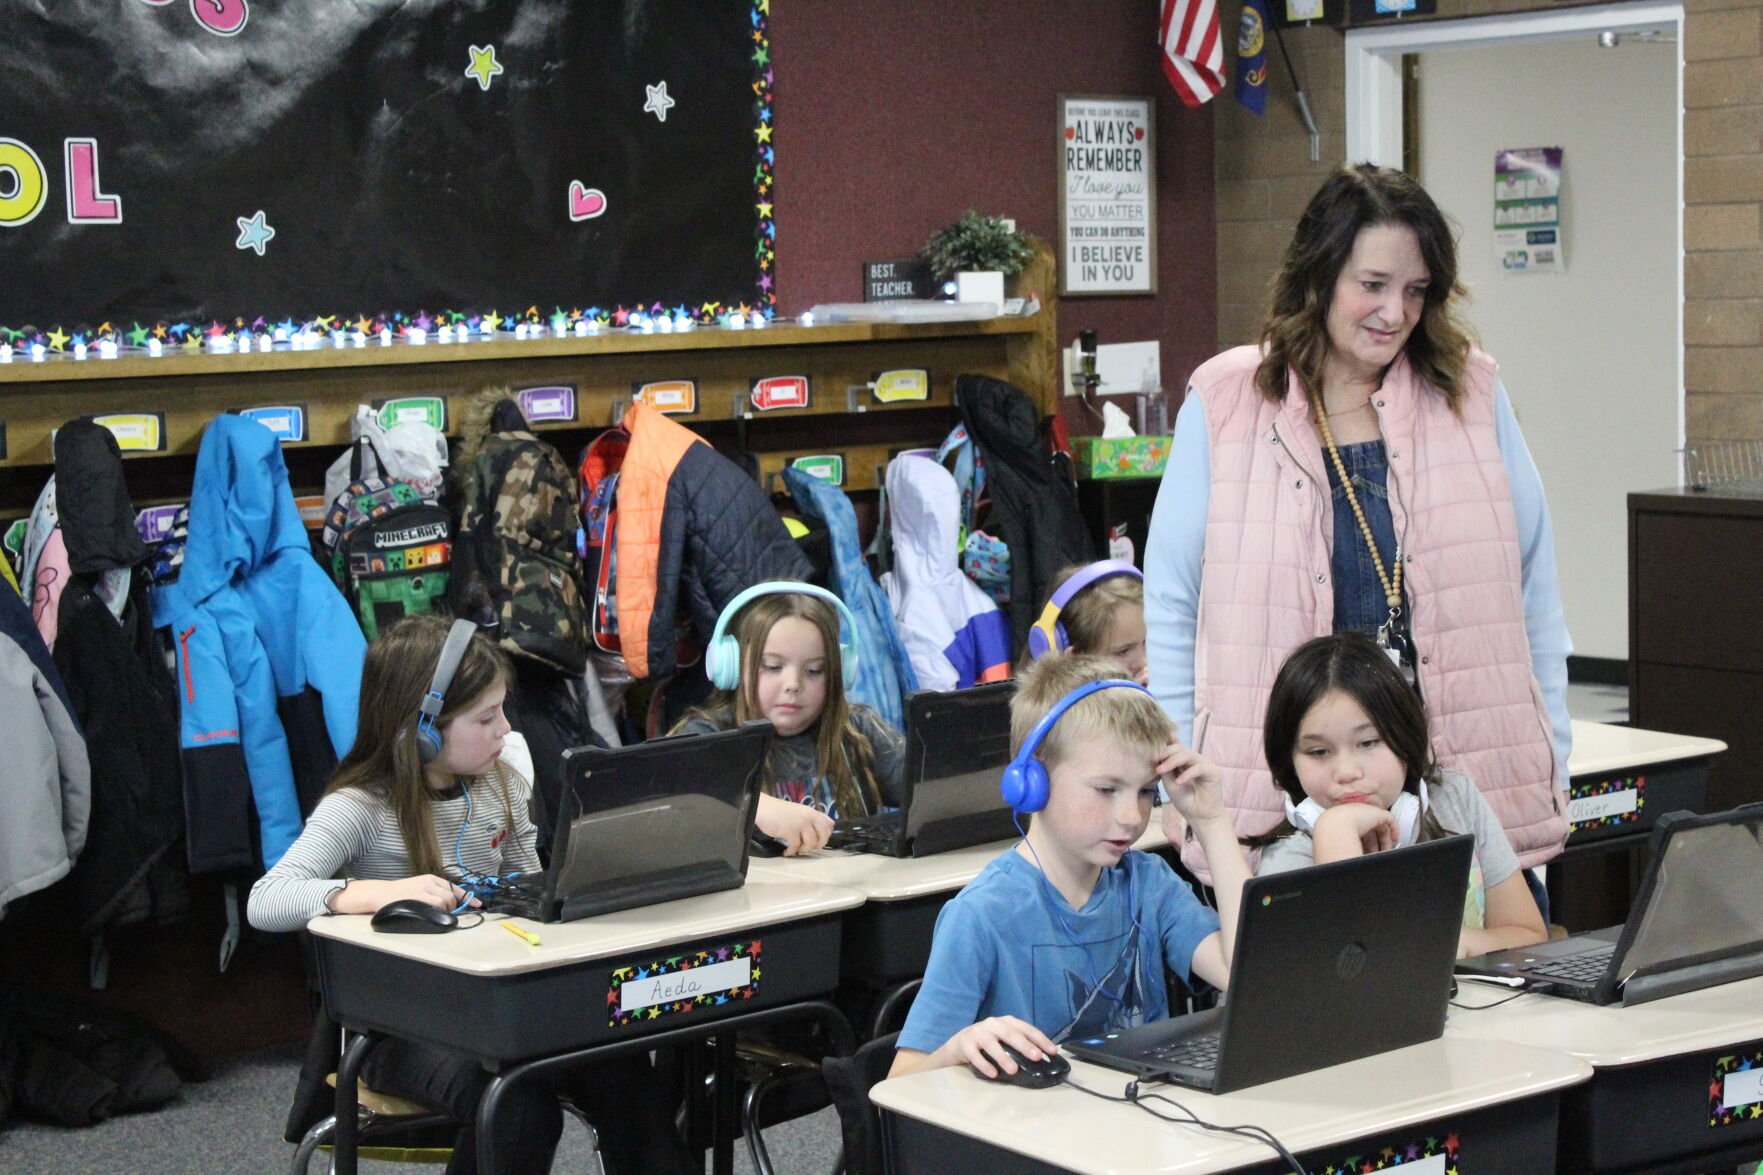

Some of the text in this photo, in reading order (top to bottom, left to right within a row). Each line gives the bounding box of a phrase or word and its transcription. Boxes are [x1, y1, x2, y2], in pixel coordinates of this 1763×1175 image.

[1075, 120, 1134, 145] ALWAYS
[1067, 147, 1142, 173] REMEMBER
[1069, 175, 1143, 201] I love you
[1072, 204, 1143, 218] YOU MATTER
[1070, 225, 1145, 238] YOU CAN DO ANYTHING
[1072, 246, 1143, 263] I BELIEVE
[1082, 265, 1134, 282] IN YOU
[375, 522, 448, 547] MINECRAFT
[1571, 801, 1610, 819] Oliver
[650, 976, 703, 1001] Aeda
